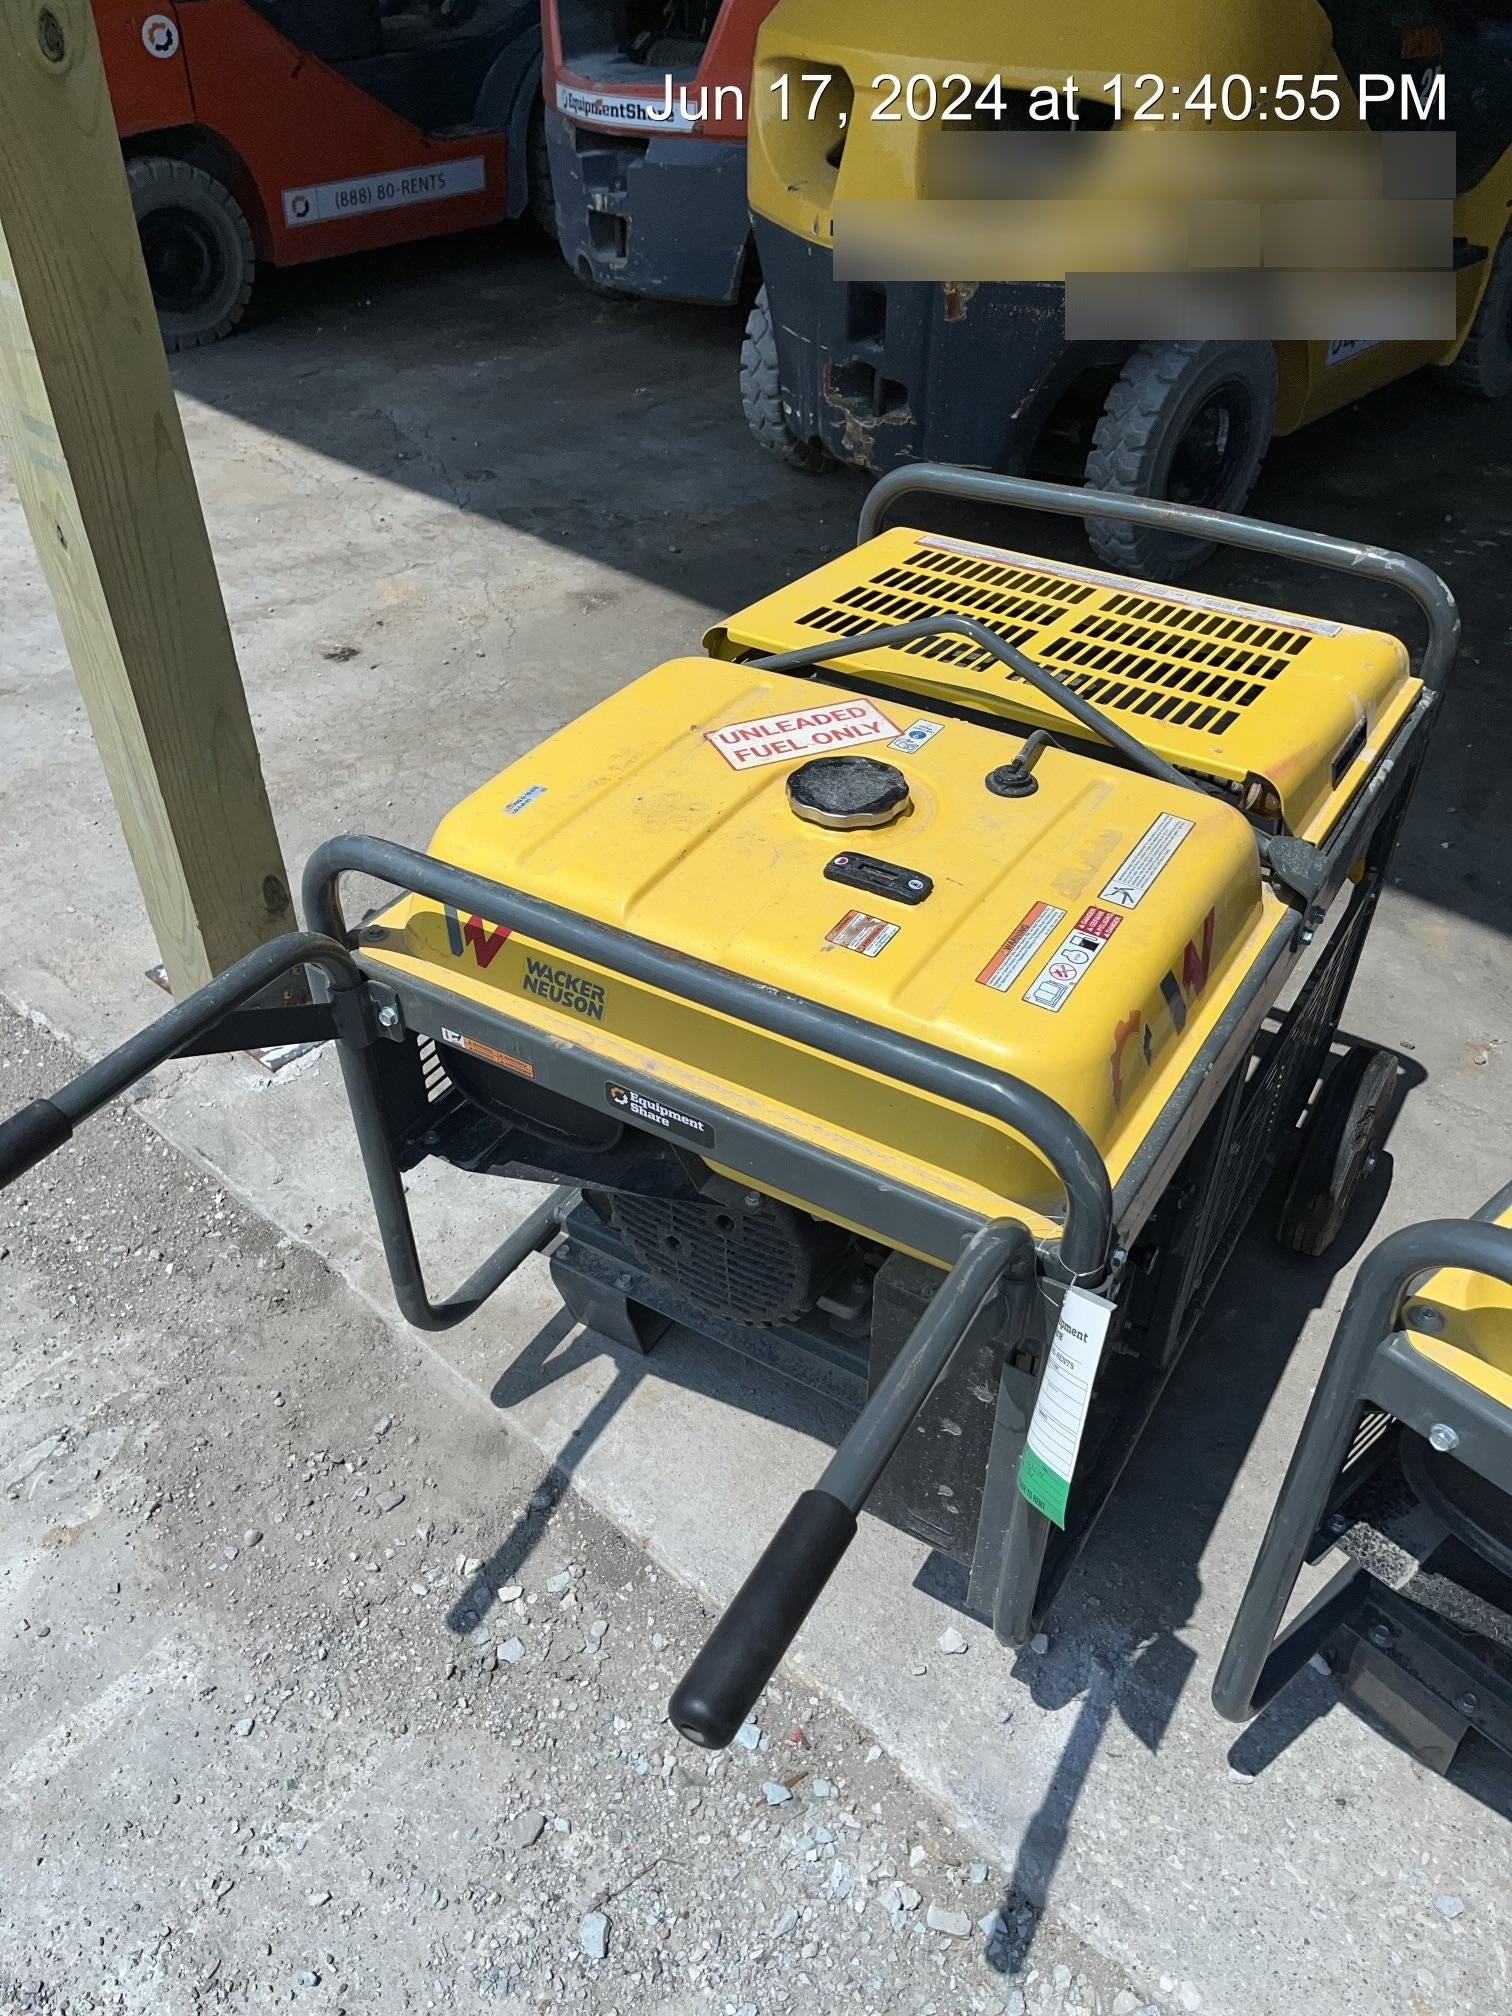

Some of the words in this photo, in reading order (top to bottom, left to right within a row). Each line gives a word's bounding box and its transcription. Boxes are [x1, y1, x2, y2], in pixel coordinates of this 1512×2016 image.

[335, 188, 372, 210] (888)
[377, 172, 446, 200] 80-RENTS
[719, 706, 867, 745] UNLEADED
[733, 738, 808, 763] FUEL
[811, 721, 882, 745] ONLY
[1002, 924, 1029, 951] WARNING
[522, 974, 605, 1020] NEUSON
[526, 957, 605, 1002] WACKER
[629, 1091, 705, 1132] Equipment
[630, 1103, 670, 1127] Share
[1059, 1319, 1088, 1344] pment
